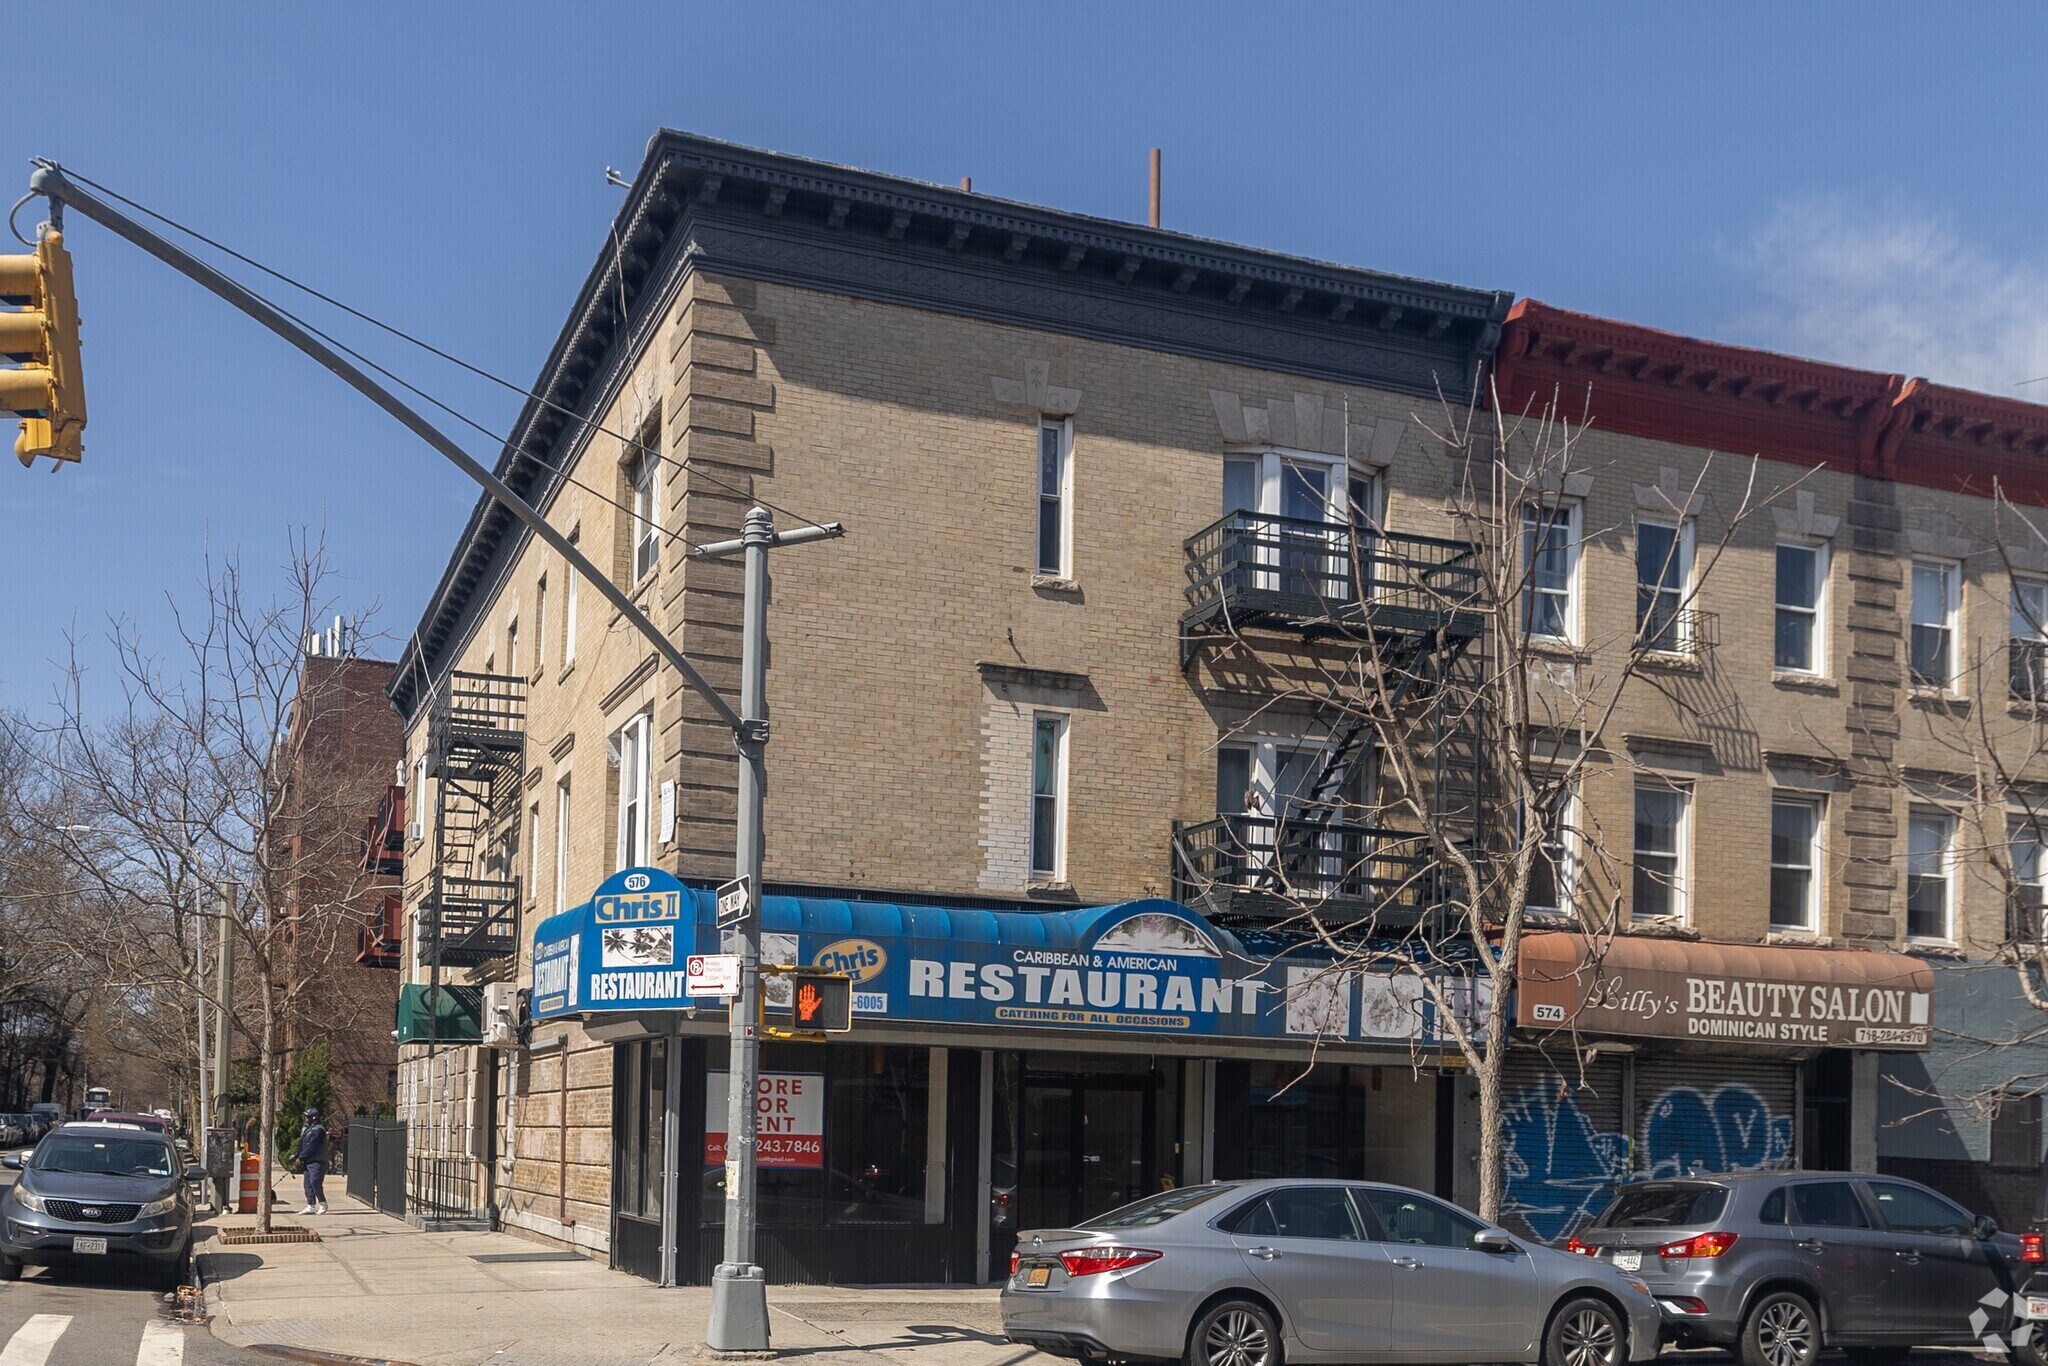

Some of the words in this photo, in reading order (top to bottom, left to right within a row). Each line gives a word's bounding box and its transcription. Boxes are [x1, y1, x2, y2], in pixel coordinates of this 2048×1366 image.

[629, 876, 646, 888] 576
[596, 894, 663, 921] Chris
[665, 894, 677, 917] II
[720, 896, 729, 914] ONE
[730, 891, 741, 910] WAY
[819, 945, 879, 974] Chris
[1013, 950, 1089, 967] CARIBBEAN
[1094, 957, 1103, 968] &
[1106, 956, 1177, 971] AMERICAN
[591, 971, 685, 1001] RESTAURANT
[909, 959, 1265, 1014] RESTAURANT
[852, 995, 883, 1009] -6005
[1686, 978, 1805, 1018] BEAUTY
[1810, 986, 1905, 1023] SALON
[1000, 1008, 1059, 1020] CATERING
[1062, 1012, 1085, 1021] FOR
[1090, 1013, 1110, 1023] ALL
[1116, 1016, 1185, 1026] OCCASIONS
[1537, 1007, 1561, 1019] 574
[1688, 1018, 1776, 1039] DOMINICAN
[1780, 1025, 1828, 1041] STYLE
[757, 1078, 803, 1094] ORE
[757, 1097, 788, 1113] OR
[757, 1116, 795, 1132] ENT
